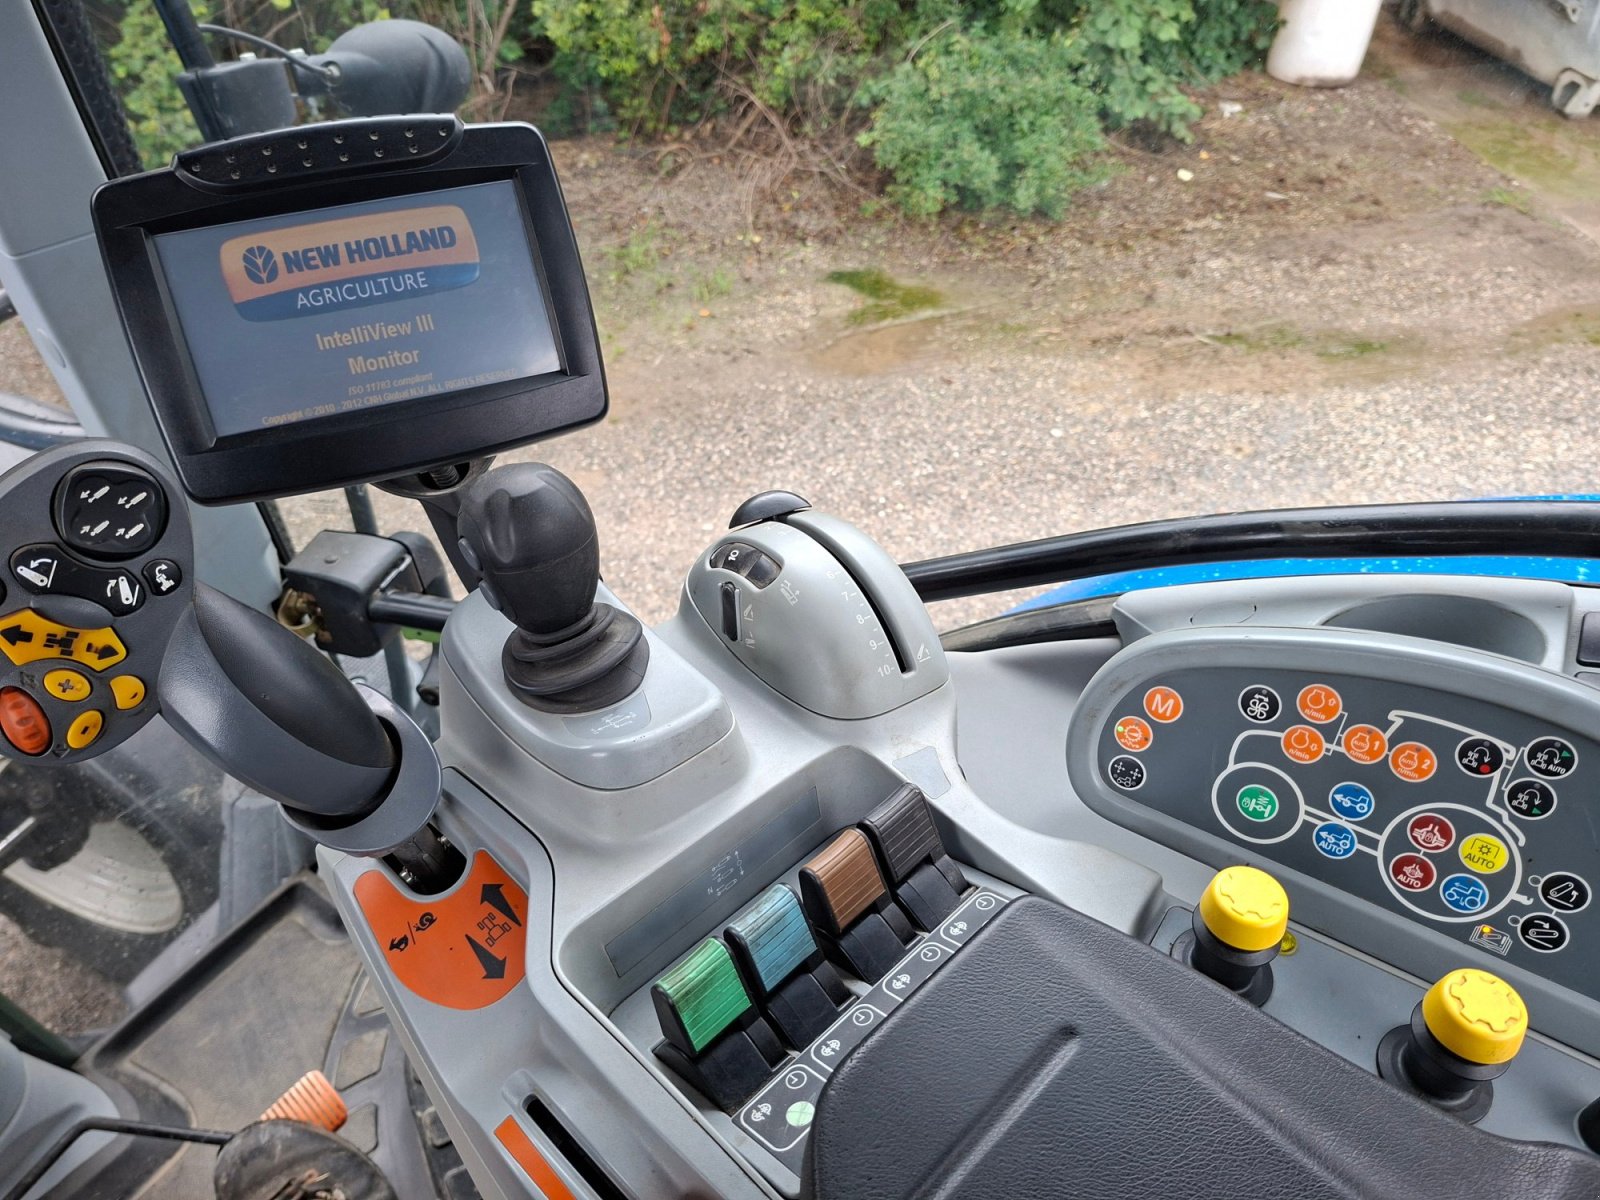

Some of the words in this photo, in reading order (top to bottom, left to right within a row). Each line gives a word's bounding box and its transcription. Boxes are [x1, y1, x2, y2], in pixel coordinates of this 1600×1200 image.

[282, 242, 341, 275] NEW
[343, 225, 457, 264] HOLLAND
[296, 271, 429, 309] AGRICULTURE
[316, 318, 412, 351] IntelliView
[416, 314, 435, 333] III
[348, 348, 420, 375] Monitor
[348, 385, 364, 396] ISO
[365, 379, 391, 393] 11783
[392, 372, 433, 388] compliant
[262, 410, 304, 426] Copyright
[342, 398, 364, 410] 2012
[444, 376, 475, 390] RIGHTS
[728, 549, 740, 561] 10
[841, 591, 850, 601] 7
[855, 614, 865, 625] 8
[869, 639, 879, 651] 9
[877, 664, 891, 677] 10
[1151, 693, 1175, 717] M
[1372, 740, 1381, 751] 1
[1421, 759, 1431, 770] 2
[1547, 763, 1567, 775] AUTO
[1318, 840, 1344, 855] AUTO
[1464, 852, 1496, 870] AUTO
[1396, 873, 1422, 888] AUTO
